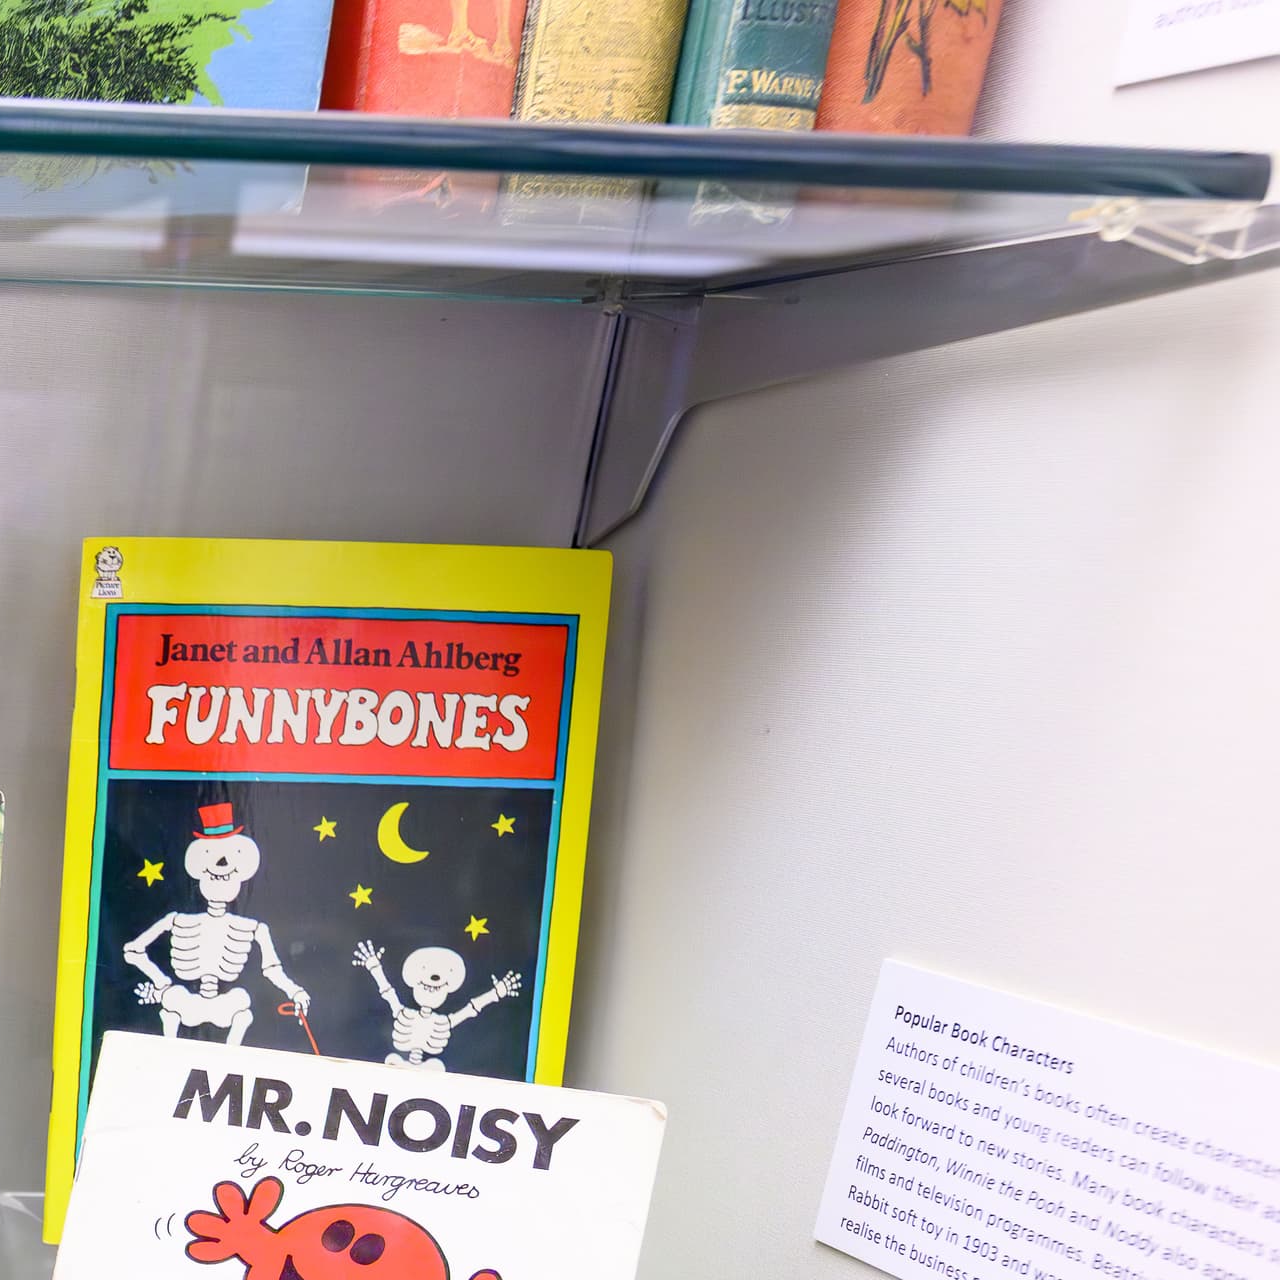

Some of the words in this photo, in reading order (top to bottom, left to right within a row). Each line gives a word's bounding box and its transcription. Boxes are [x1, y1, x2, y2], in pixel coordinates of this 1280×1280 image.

[156, 634, 238, 666] Janet
[243, 638, 299, 664] and
[305, 638, 392, 667] Allan
[397, 641, 522, 677] Ahlberg
[145, 682, 531, 752] FUNNYBONES
[886, 1036, 938, 1066] Authors
[895, 1005, 948, 1034] Popular
[951, 1023, 988, 1047] Book
[992, 1036, 1074, 1074] Characters
[878, 1068, 926, 1095] several
[173, 1068, 312, 1137] MR.
[322, 1088, 580, 1171] NOISY
[234, 1142, 267, 1178] by
[279, 1149, 343, 1181] Roger
[350, 1162, 480, 1200] Hargreaves
[863, 1126, 941, 1171] Paddington,
[962, 1235, 999, 1262] 1903
